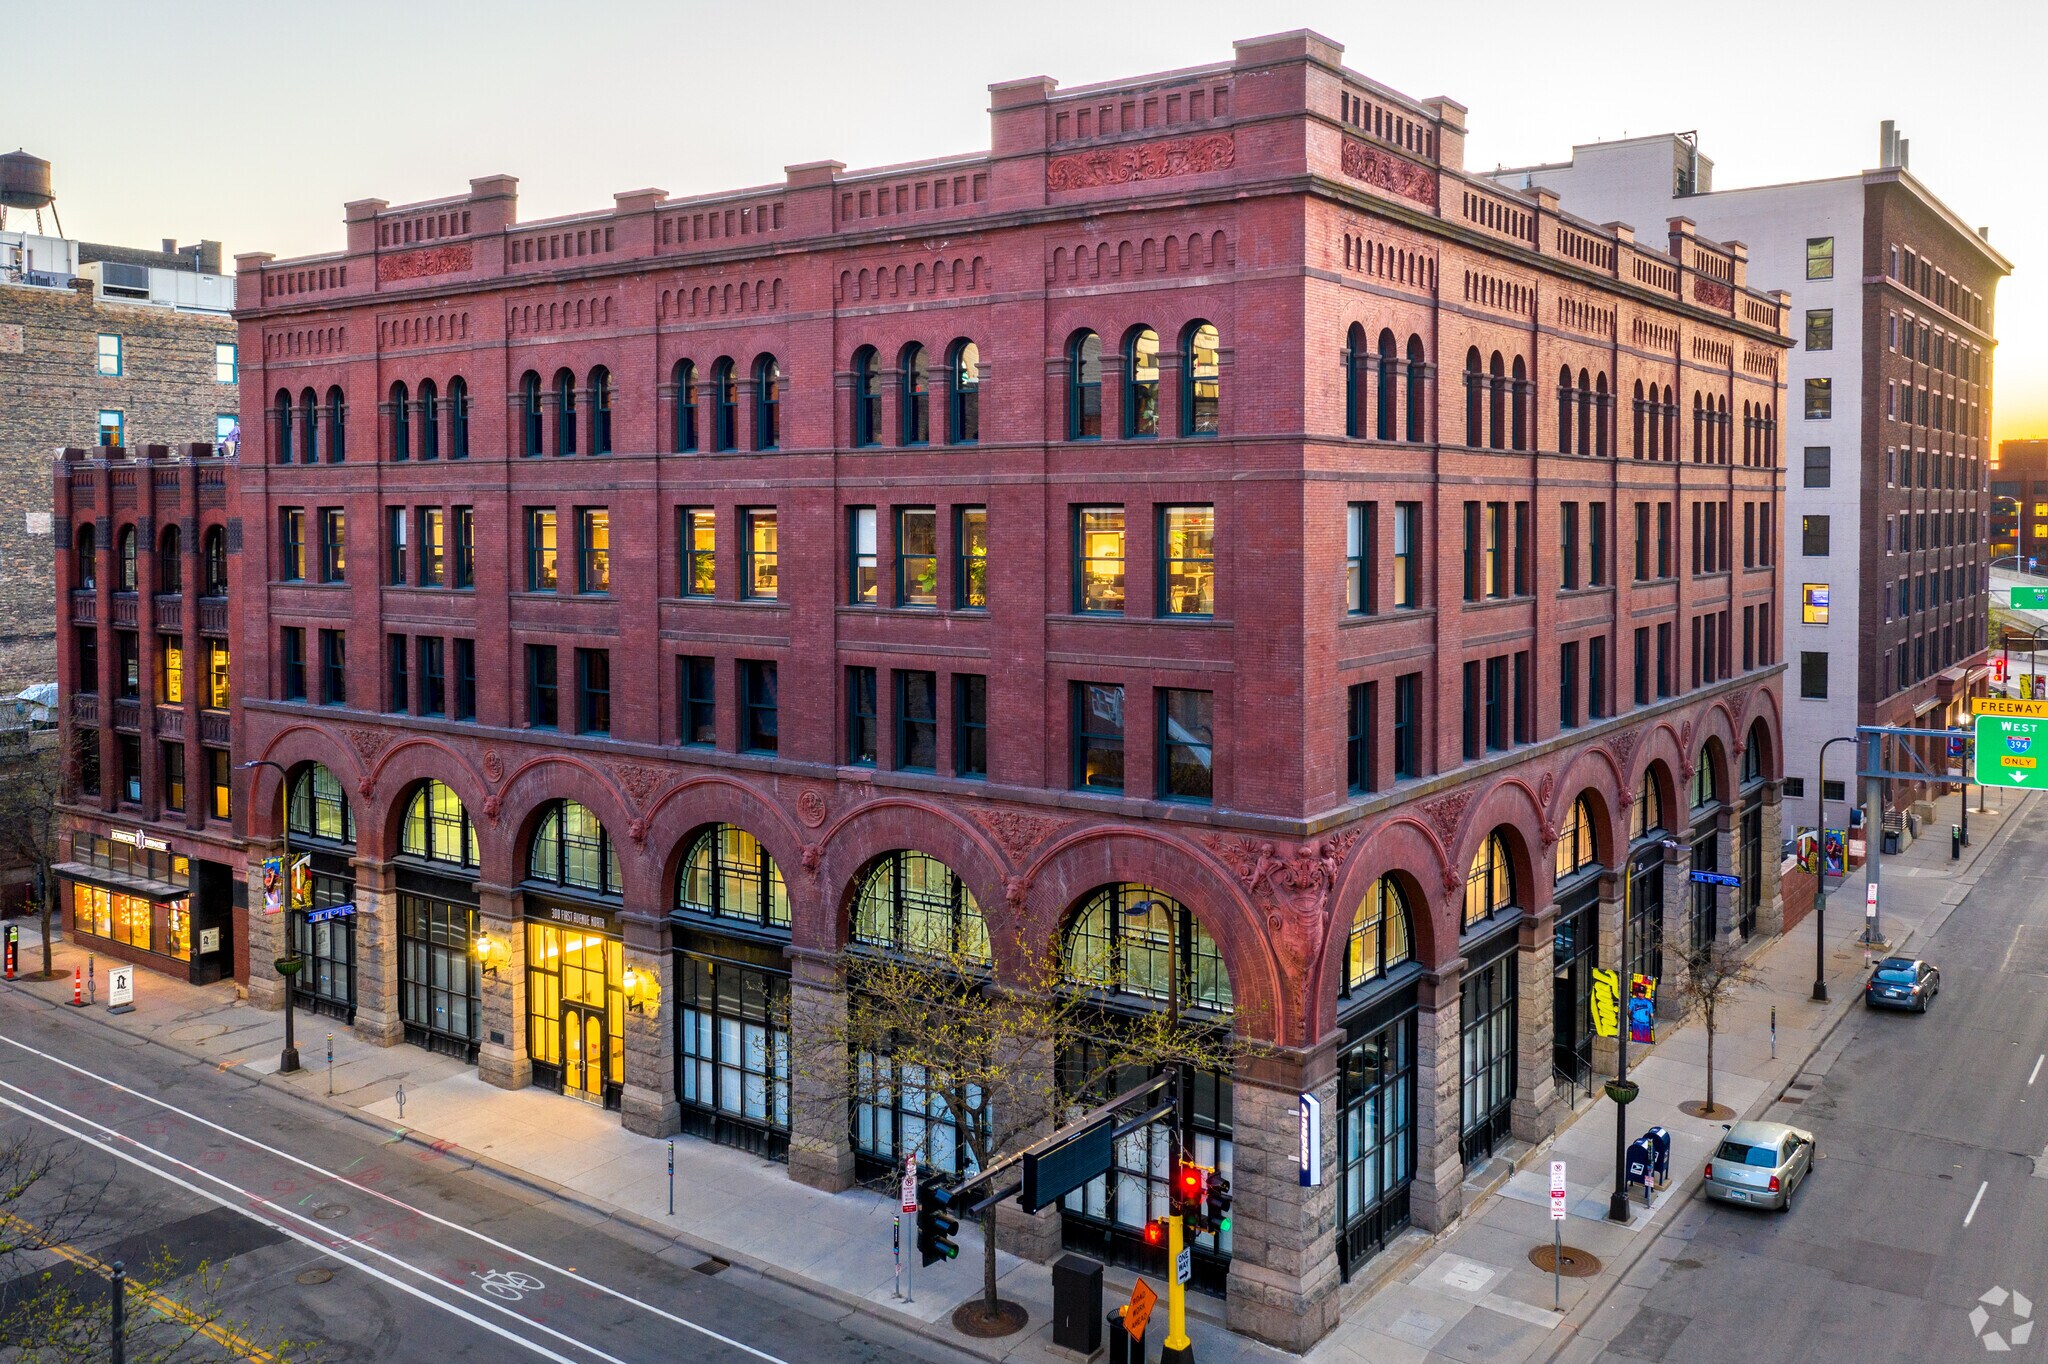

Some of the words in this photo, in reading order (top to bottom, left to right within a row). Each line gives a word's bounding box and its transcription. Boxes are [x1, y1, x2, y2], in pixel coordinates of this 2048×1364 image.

[1981, 702, 2042, 714] FREEWAY
[2001, 721, 2038, 733] WEST
[2010, 740, 2028, 750] 394
[2004, 757, 2032, 766] ONLY
[552, 908, 560, 919] 300
[561, 910, 573, 921] FIRST
[574, 912, 590, 925] AVENUE
[1178, 1250, 1189, 1263] ONE
[1178, 1261, 1189, 1272] WAY
[1132, 1290, 1147, 1304] ROAD
[1132, 1303, 1146, 1317] WORK
[1131, 1312, 1148, 1329] AHEAD
